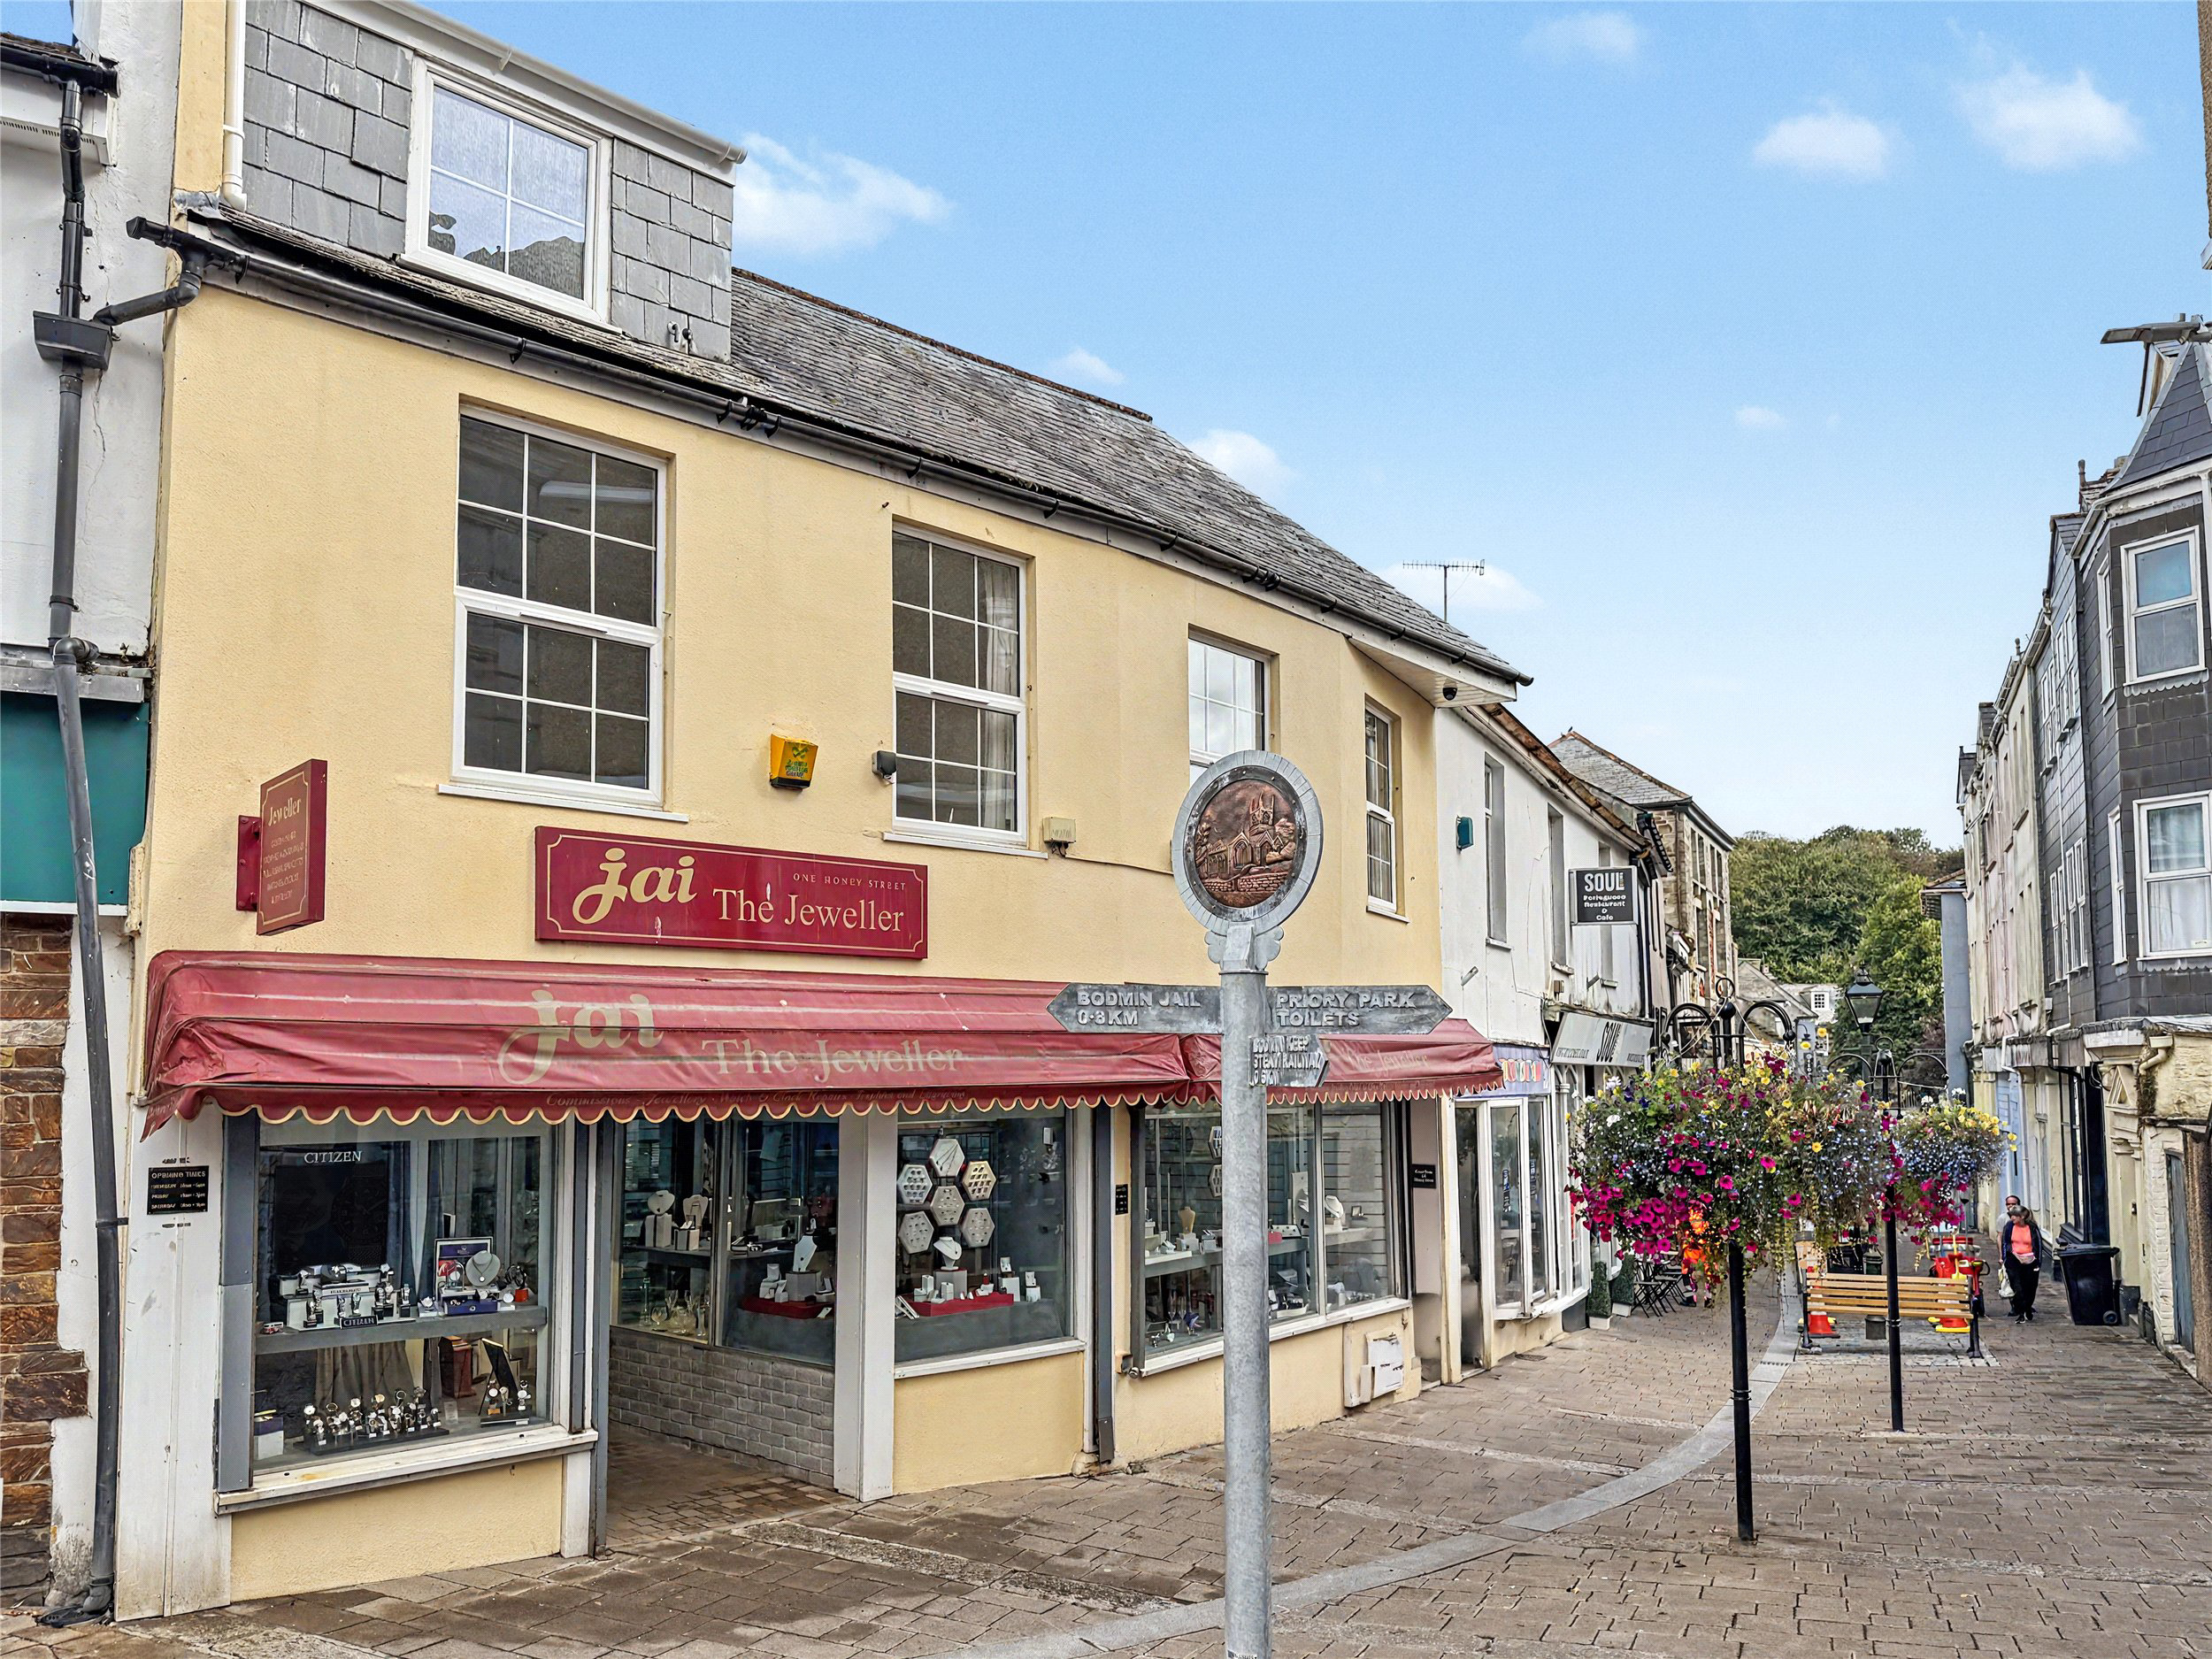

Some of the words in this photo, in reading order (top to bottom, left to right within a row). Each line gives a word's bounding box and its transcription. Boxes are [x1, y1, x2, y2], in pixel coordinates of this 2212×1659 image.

[268, 797, 301, 826] Jeweller
[793, 872, 817, 883] ONE
[825, 875, 863, 887] HONEY
[869, 879, 906, 891] STREET
[712, 887, 774, 924] The
[784, 893, 904, 932] Jeweller
[1077, 991, 1153, 1007] BODMIN
[1158, 991, 1202, 1008] JAIL
[1276, 992, 1352, 1009] PRIORY
[1358, 992, 1416, 1009] PARK
[1277, 1010, 1360, 1027] TOILETS
[702, 1039, 797, 1074] The
[814, 1039, 963, 1083] Jeweller
[303, 1151, 363, 1164] CITIZEN
